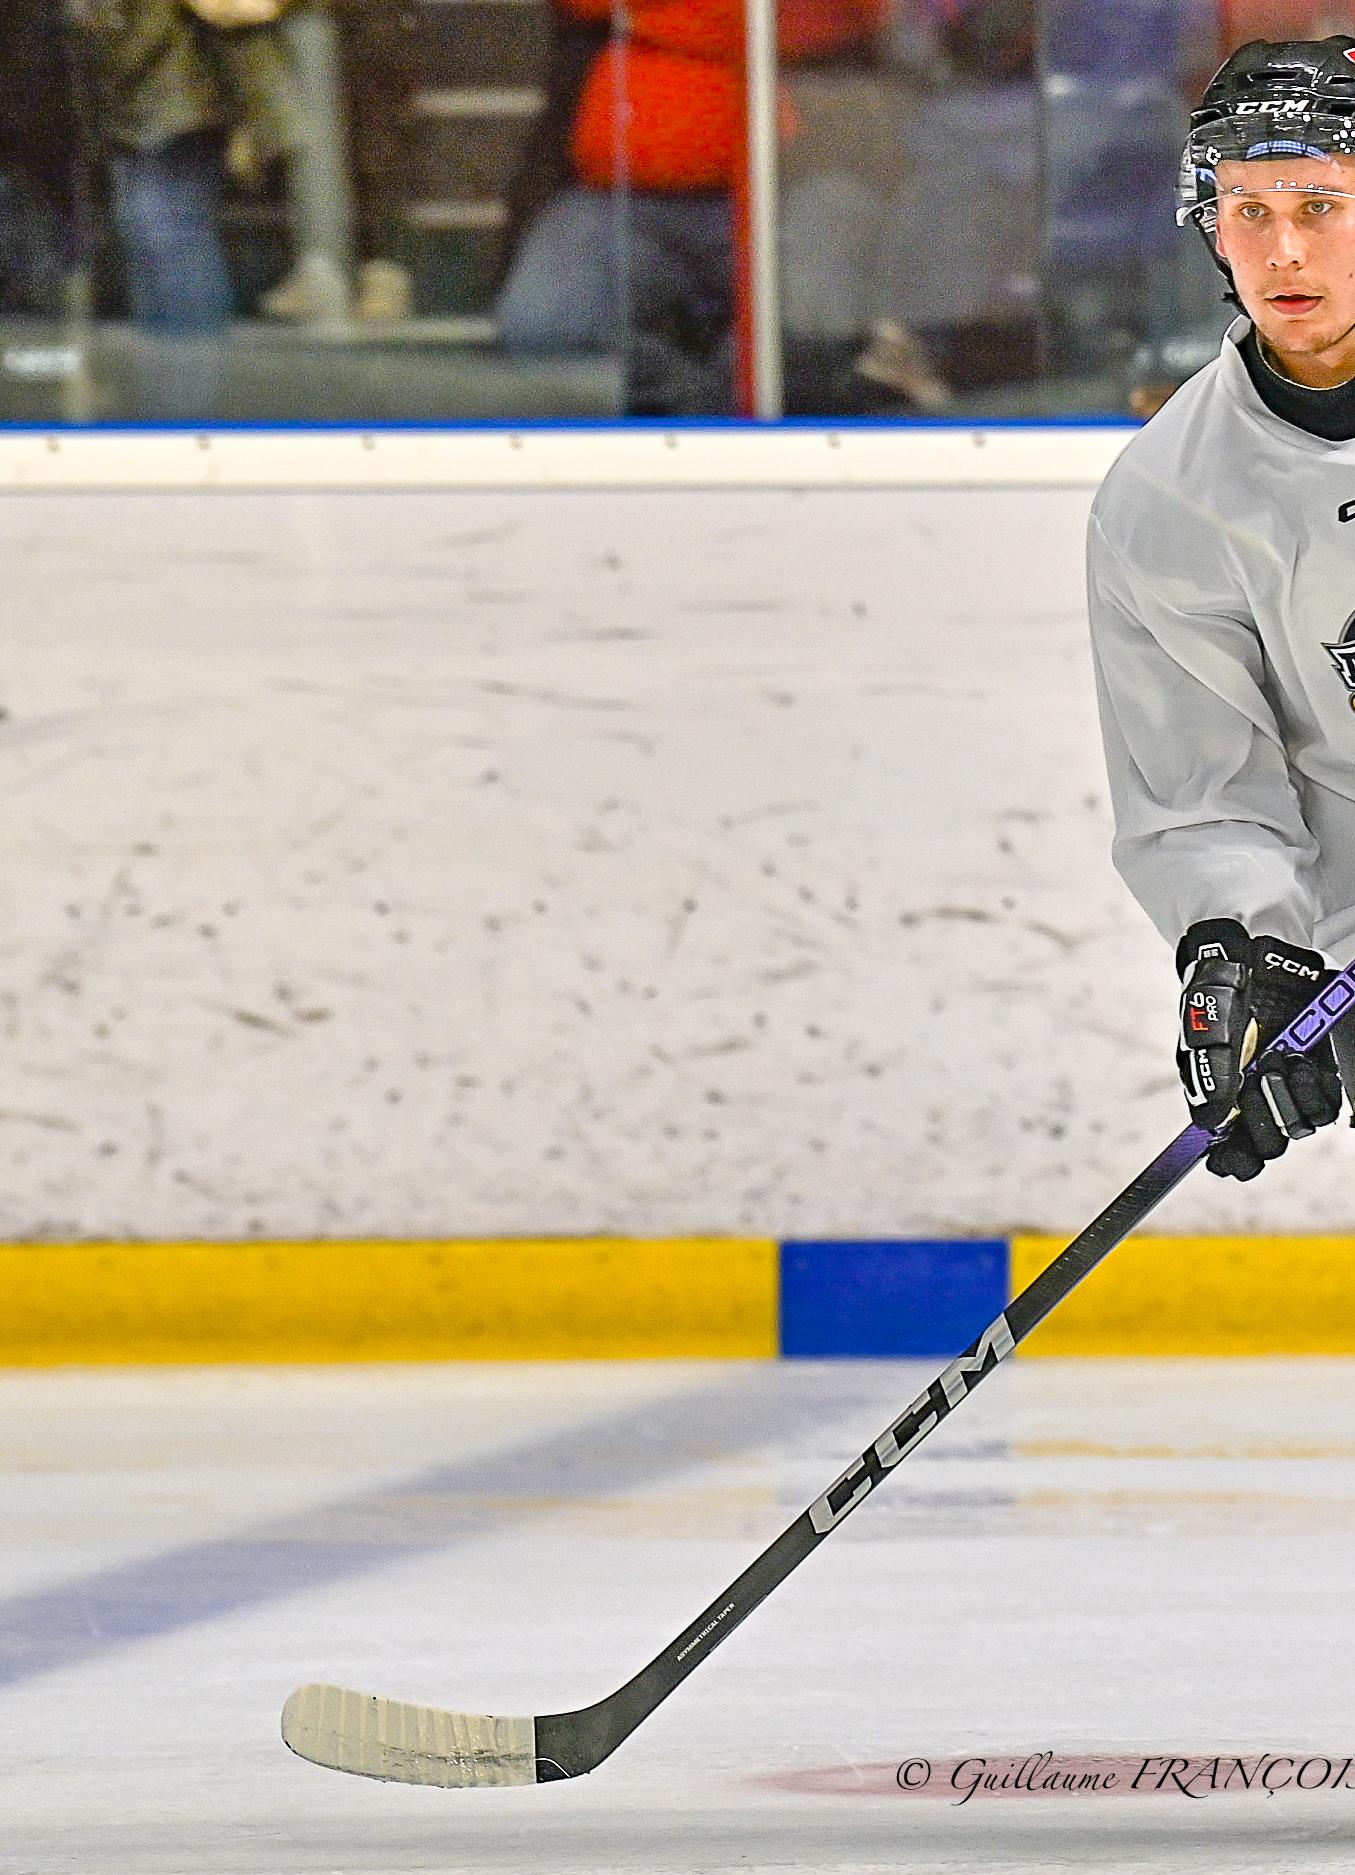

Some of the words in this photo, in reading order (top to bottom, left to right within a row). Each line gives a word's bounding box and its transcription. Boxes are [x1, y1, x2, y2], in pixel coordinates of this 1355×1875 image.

[1236, 99, 1310, 115] CCM
[1264, 951, 1320, 981] CCM
[1205, 995, 1219, 1022] PRO
[1197, 1048, 1216, 1092] CCM
[808, 1310, 1017, 1534] CCM
